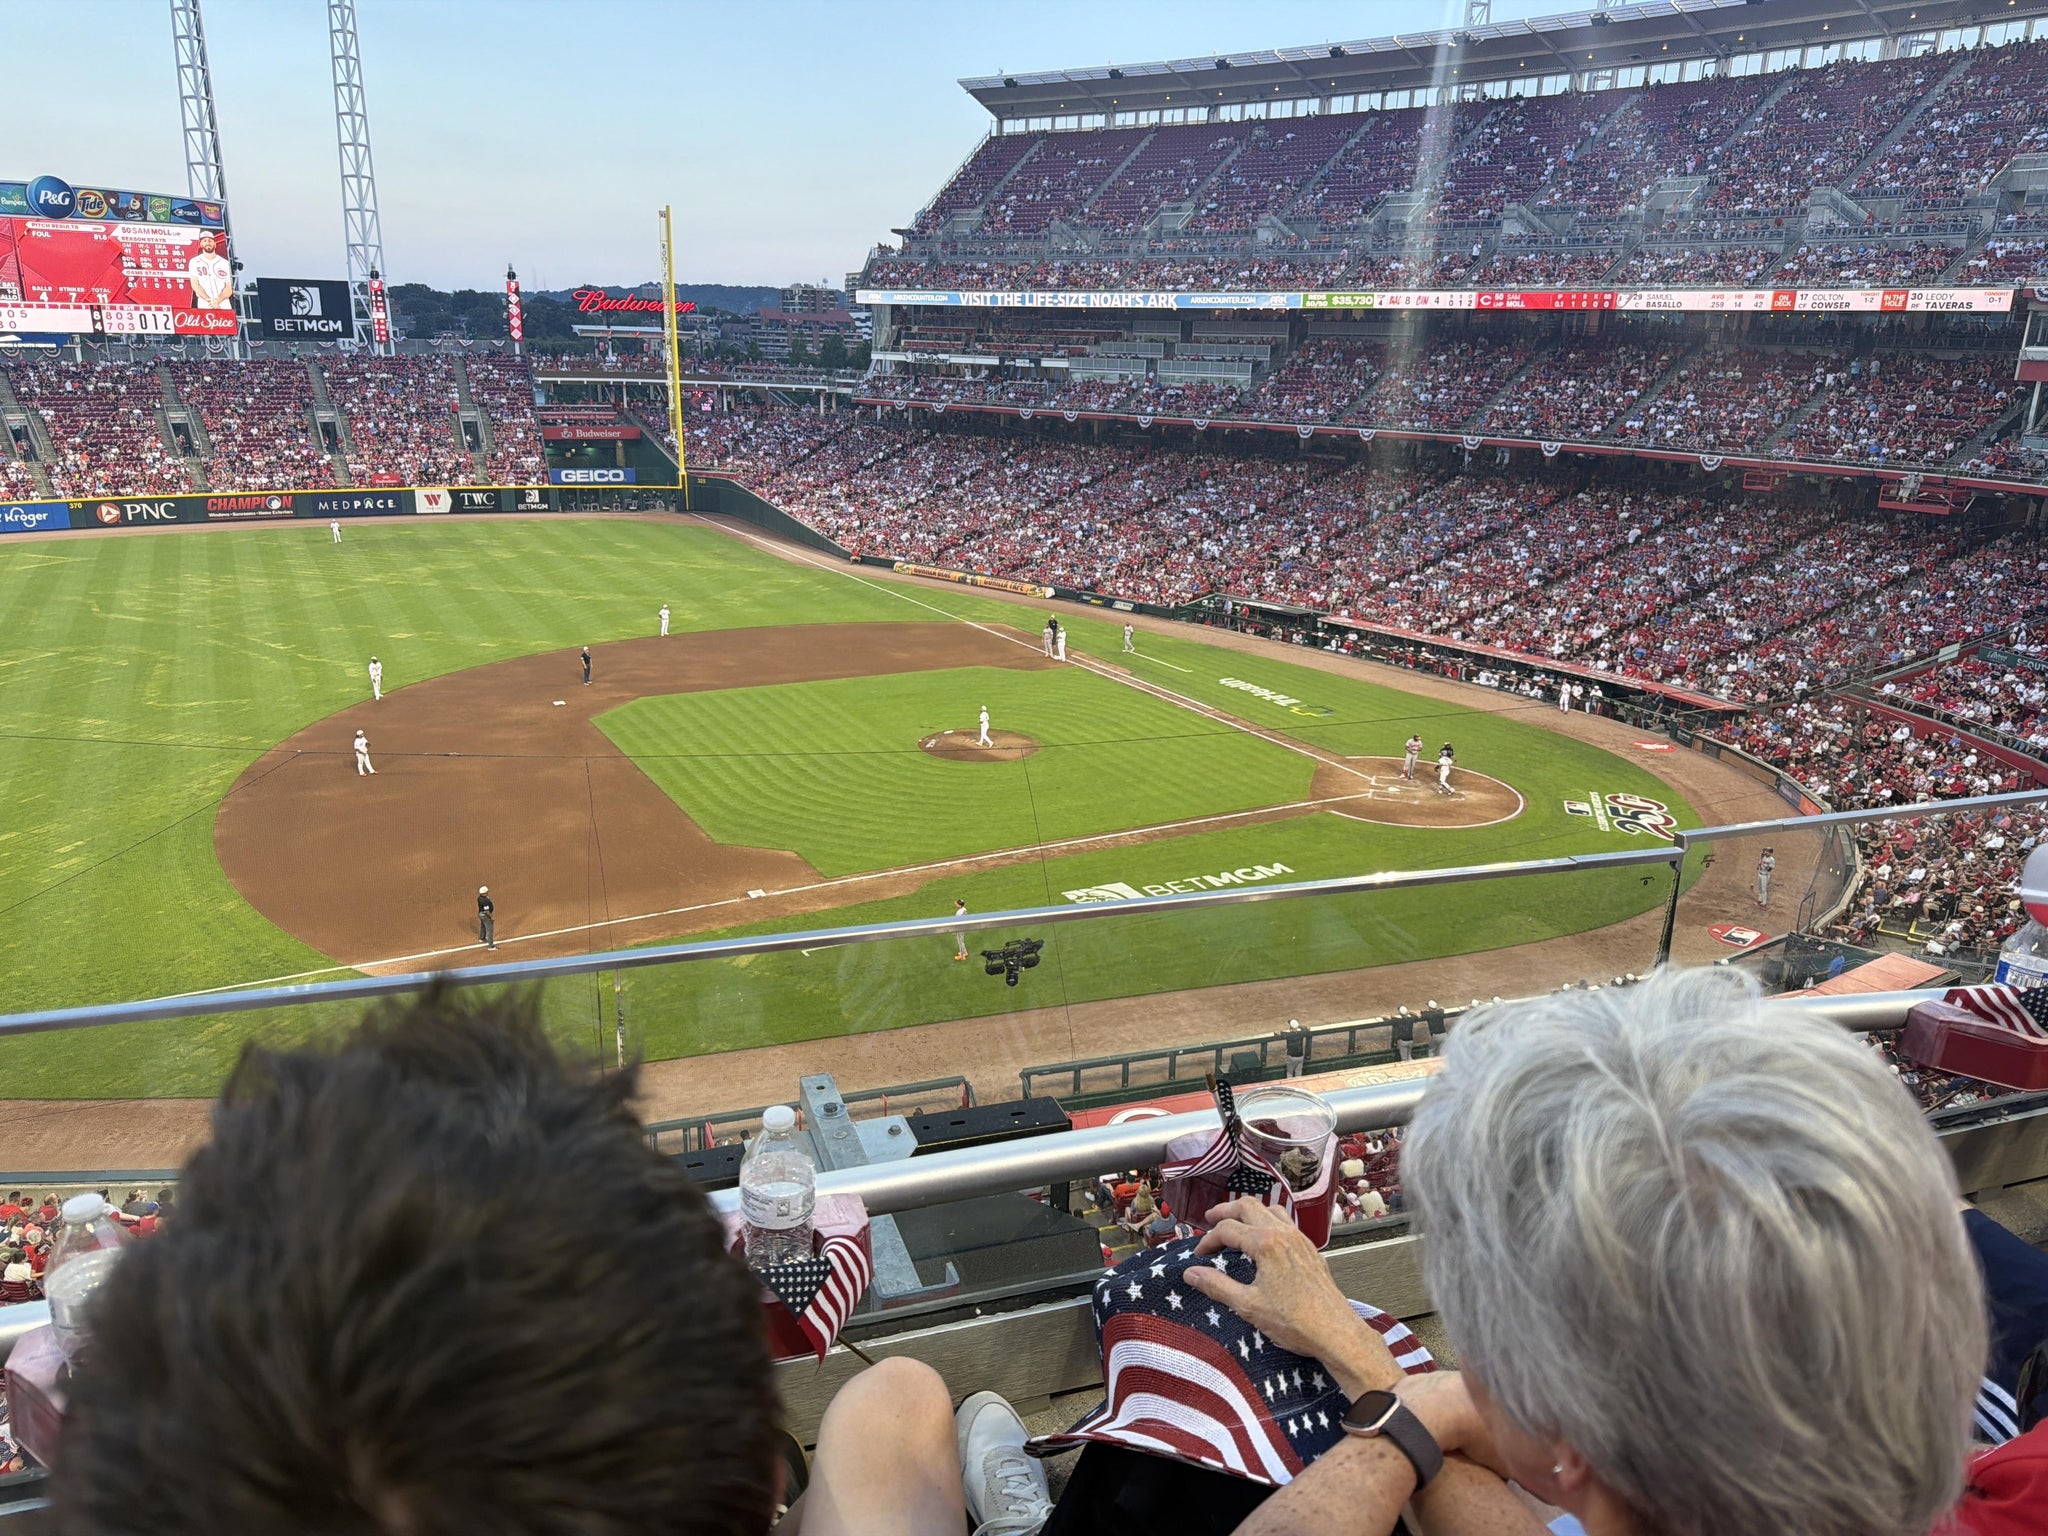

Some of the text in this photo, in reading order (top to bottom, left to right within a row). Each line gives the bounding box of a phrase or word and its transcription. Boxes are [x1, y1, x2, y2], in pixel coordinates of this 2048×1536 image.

[1, 196, 27, 206] Pampers
[39, 190, 71, 205] P&G
[79, 197, 104, 212] Tide
[132, 227, 150, 235] SAM
[39, 292, 108, 304] 4 7 11
[573, 290, 696, 313] Budweier
[893, 293, 949, 302] ARKENCOUNTER.COM
[959, 292, 1178, 308] VISIT THE LIFE-SIZE NOAH'S ARK
[1190, 296, 1257, 304] ARKENCOUNTER.COM
[1331, 295, 1374, 306] $35,730
[1405, 296, 1411, 304] 8
[1434, 296, 1440, 304] 4
[1911, 292, 1955, 301] 30 LEODY
[1925, 302, 1973, 310] TAVERAS
[20, 310, 28, 318] 5
[94, 311, 101, 320] 8
[105, 312, 112, 320] 8
[174, 312, 234, 330] Old Spice
[9, 320, 136, 331] 0 4 7 0 3
[274, 318, 343, 332] BETMGM
[575, 429, 622, 438] Budweiser
[560, 470, 625, 482] GEICO
[207, 496, 293, 511] CHAMPION
[318, 497, 396, 511] MEDPACE
[460, 492, 495, 506] TWC
[5, 506, 49, 528] Kroger
[123, 502, 177, 521] PNC
[1219, 678, 1301, 707] TriHealth
[1605, 793, 1677, 841] 250
[1142, 862, 1295, 897] BETMGM
